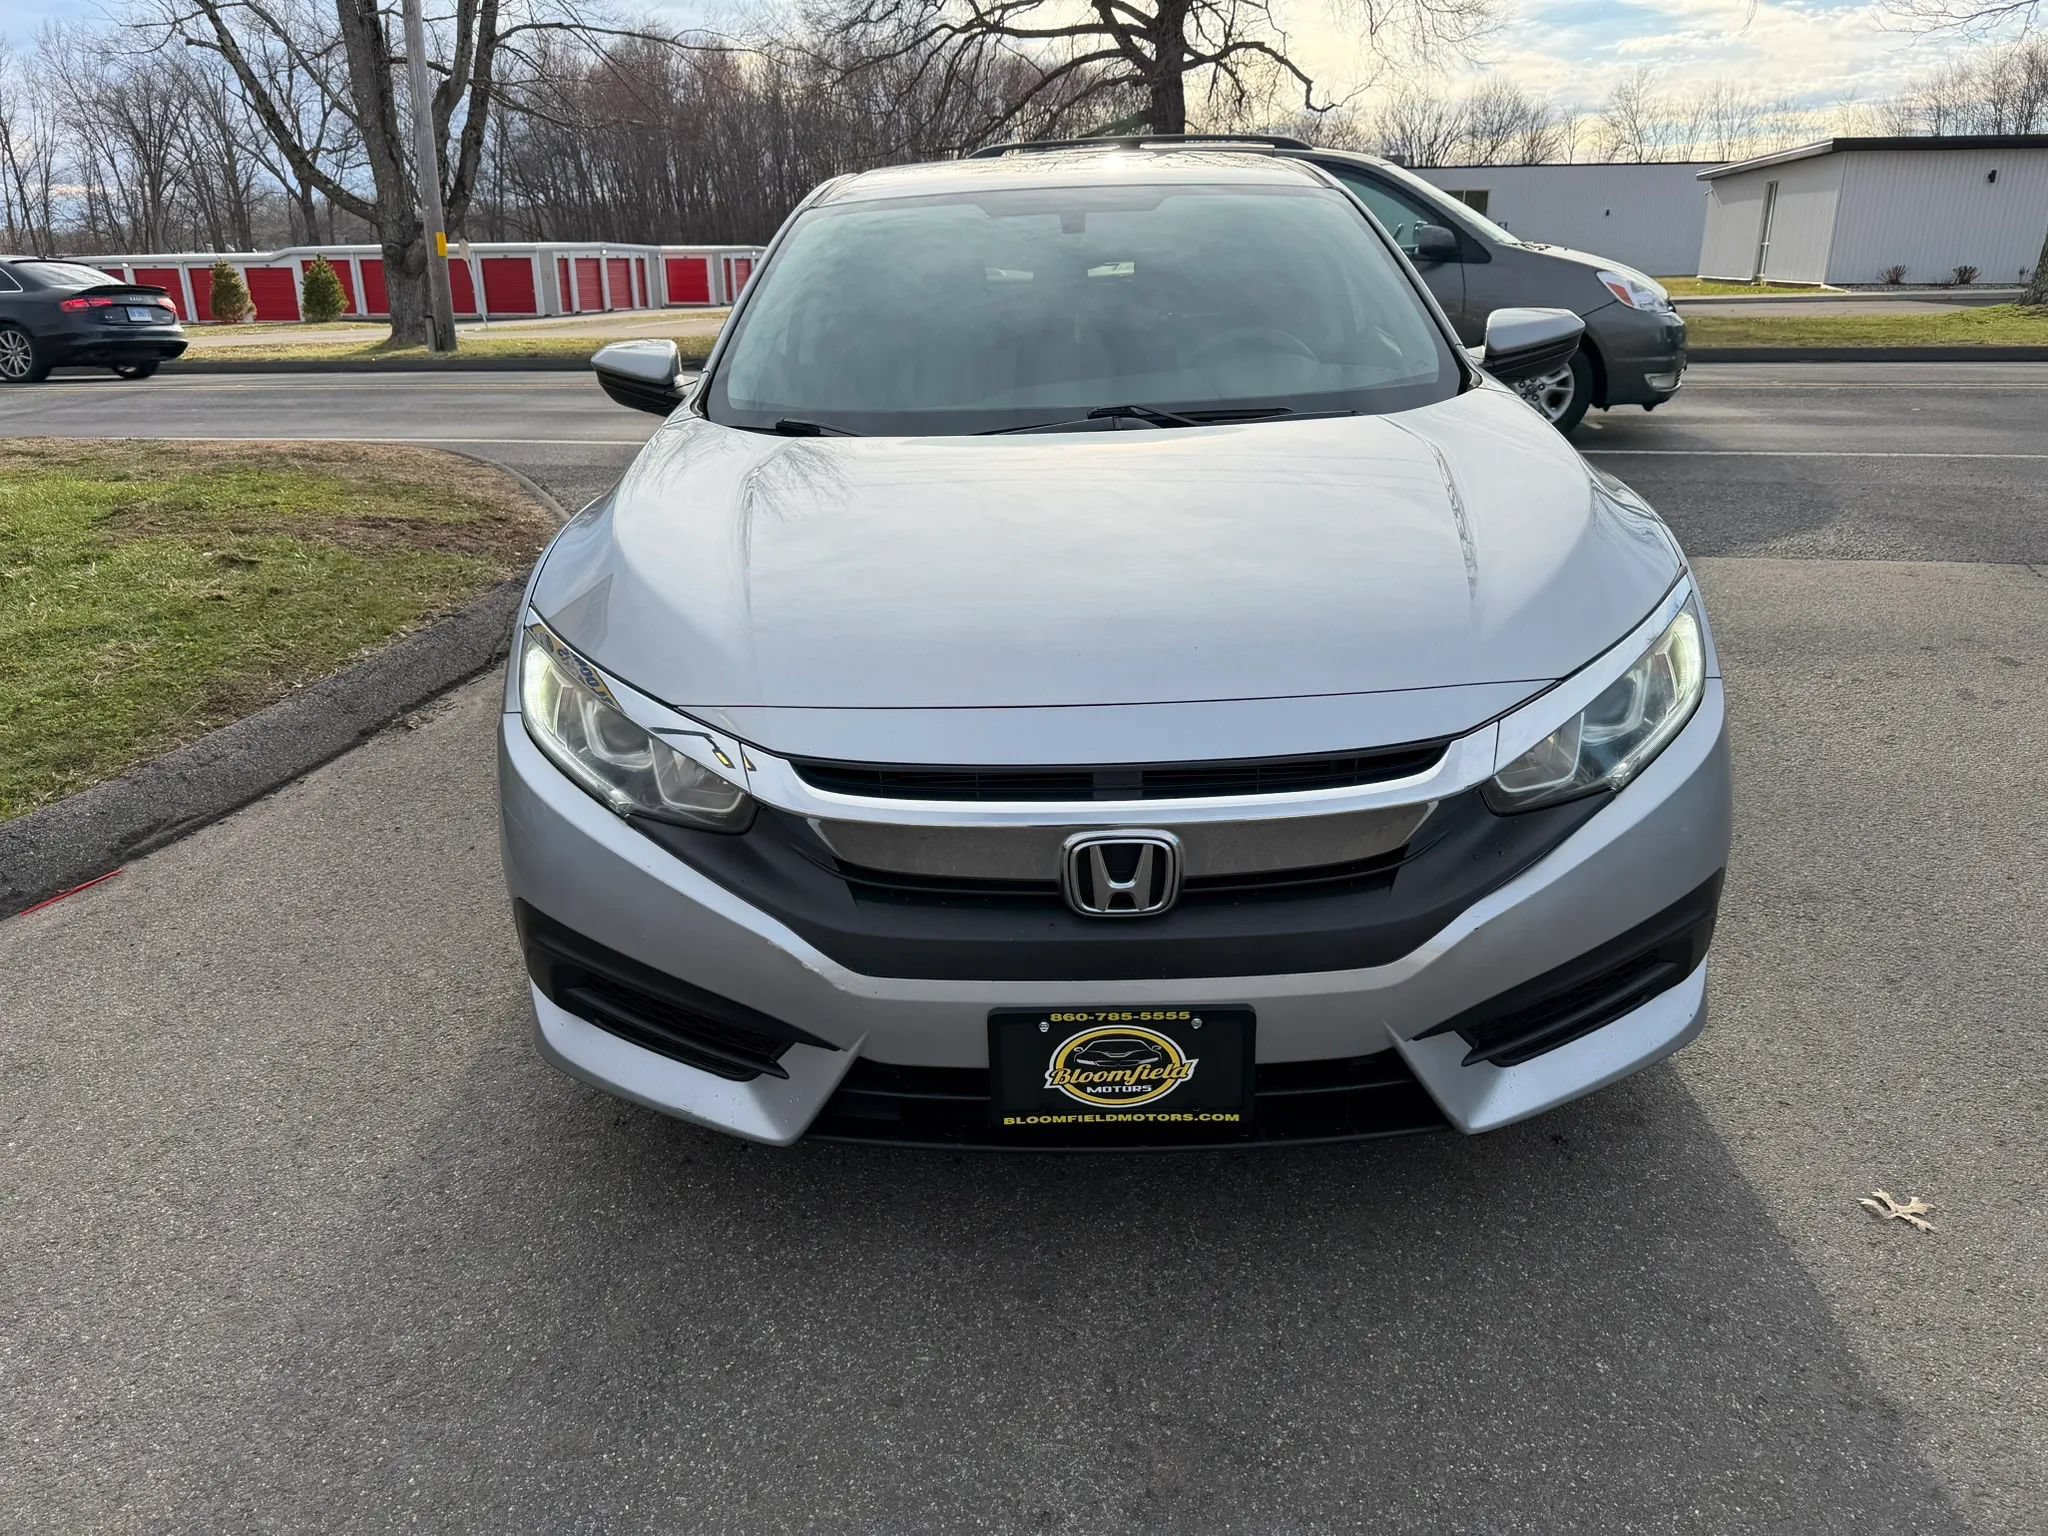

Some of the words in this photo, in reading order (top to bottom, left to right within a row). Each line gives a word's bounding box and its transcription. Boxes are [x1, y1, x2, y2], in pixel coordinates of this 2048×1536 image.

[1050, 1011, 1191, 1022] 860-785-5555
[1051, 1063, 1192, 1086] Bloomfield
[1086, 1085, 1152, 1093] MOTORS
[1003, 1113, 1240, 1125] BLOOMFIELDMOTORS.COM
